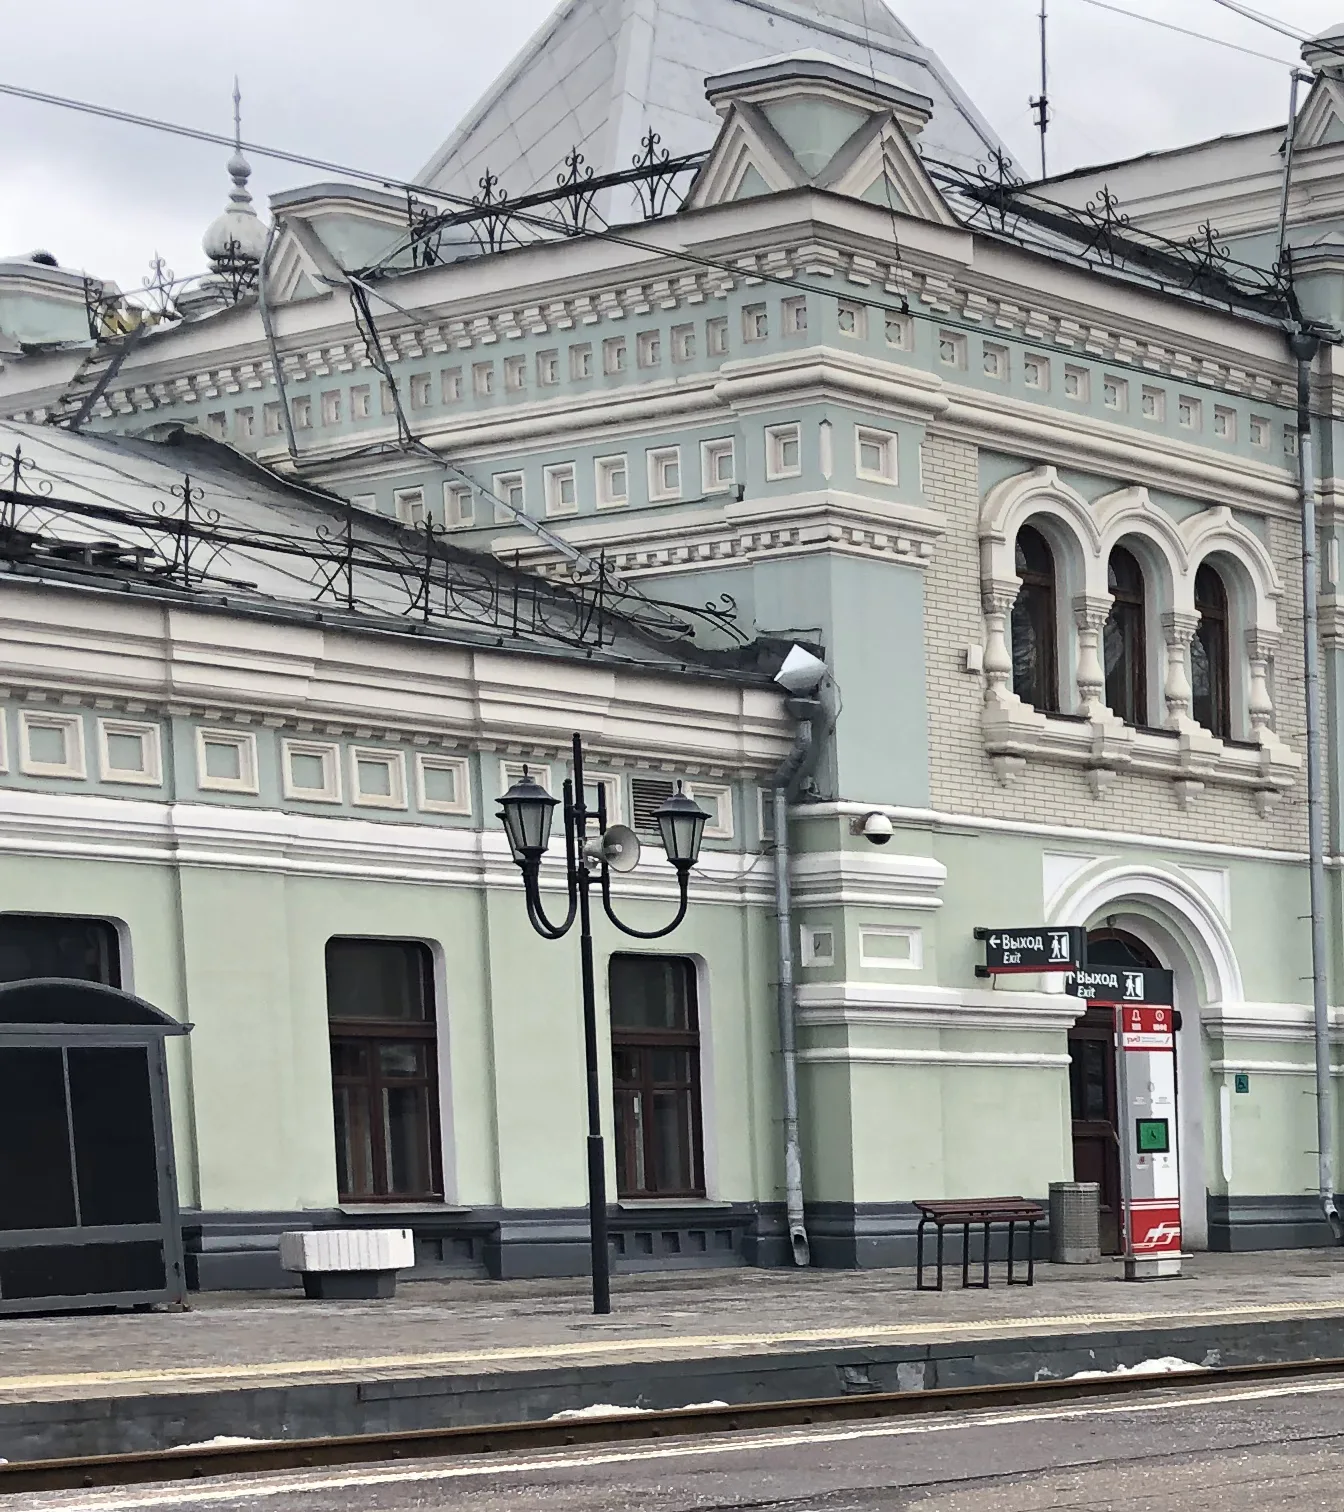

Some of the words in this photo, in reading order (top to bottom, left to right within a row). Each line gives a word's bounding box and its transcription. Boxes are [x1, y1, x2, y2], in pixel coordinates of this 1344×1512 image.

[1002, 934, 1044, 951] Выход
[1003, 952, 1021, 964] Exit
[1076, 971, 1119, 988] Выход
[1077, 986, 1096, 998] Exit
